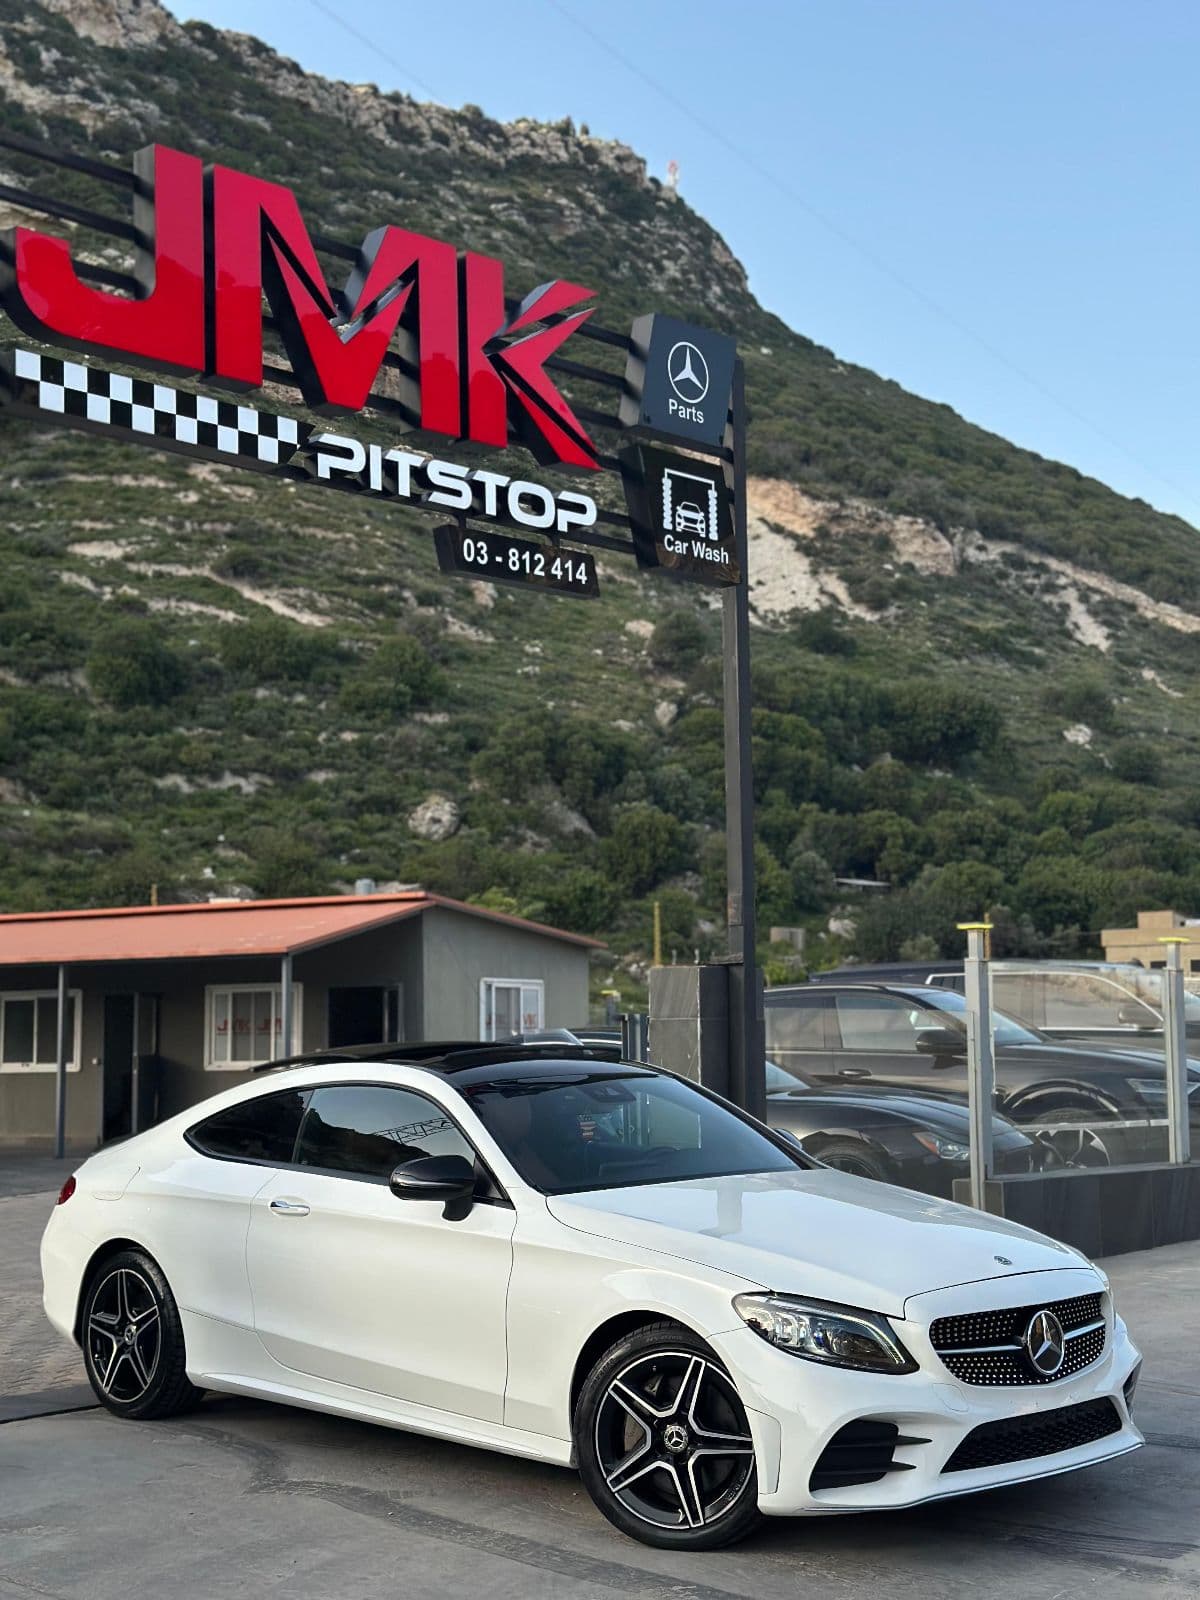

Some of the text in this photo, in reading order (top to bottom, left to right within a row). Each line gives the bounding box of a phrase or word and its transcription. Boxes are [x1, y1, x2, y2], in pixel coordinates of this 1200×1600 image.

[15, 143, 601, 471] JMK
[668, 398, 705, 424] Parts
[316, 432, 598, 533] PITSTOP
[463, 538, 488, 565] 03
[508, 547, 545, 577] 812
[551, 557, 588, 585] 414
[664, 534, 729, 565] Car Wash
